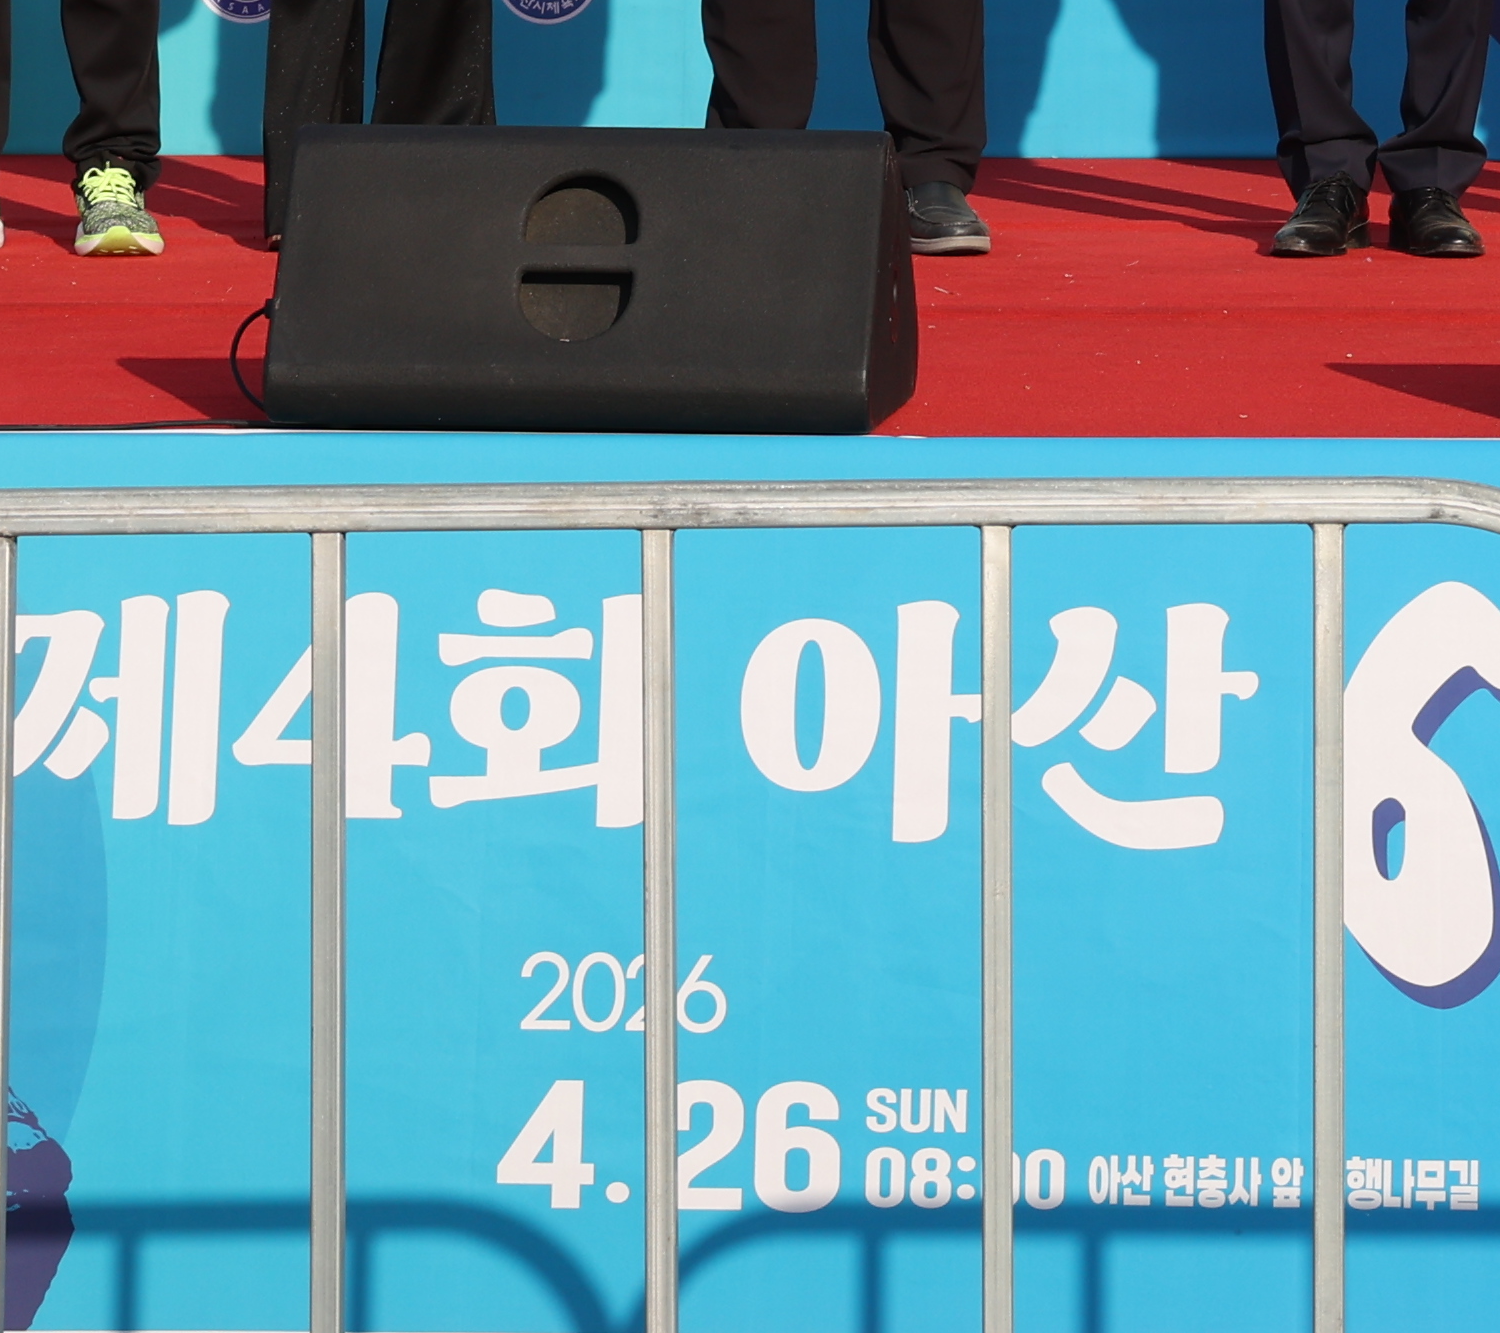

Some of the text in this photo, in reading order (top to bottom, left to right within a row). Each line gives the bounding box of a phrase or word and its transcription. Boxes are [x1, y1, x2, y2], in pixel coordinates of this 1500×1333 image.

[13, 589, 1259, 851] 제4회 아산
[865, 1087, 967, 1134] SUN
[864, 1146, 1066, 1210] 08:0
[1088, 1155, 1155, 1207] 아산
[1163, 1154, 1263, 1208] 현충사
[1270, 1156, 1305, 1209] 앞
